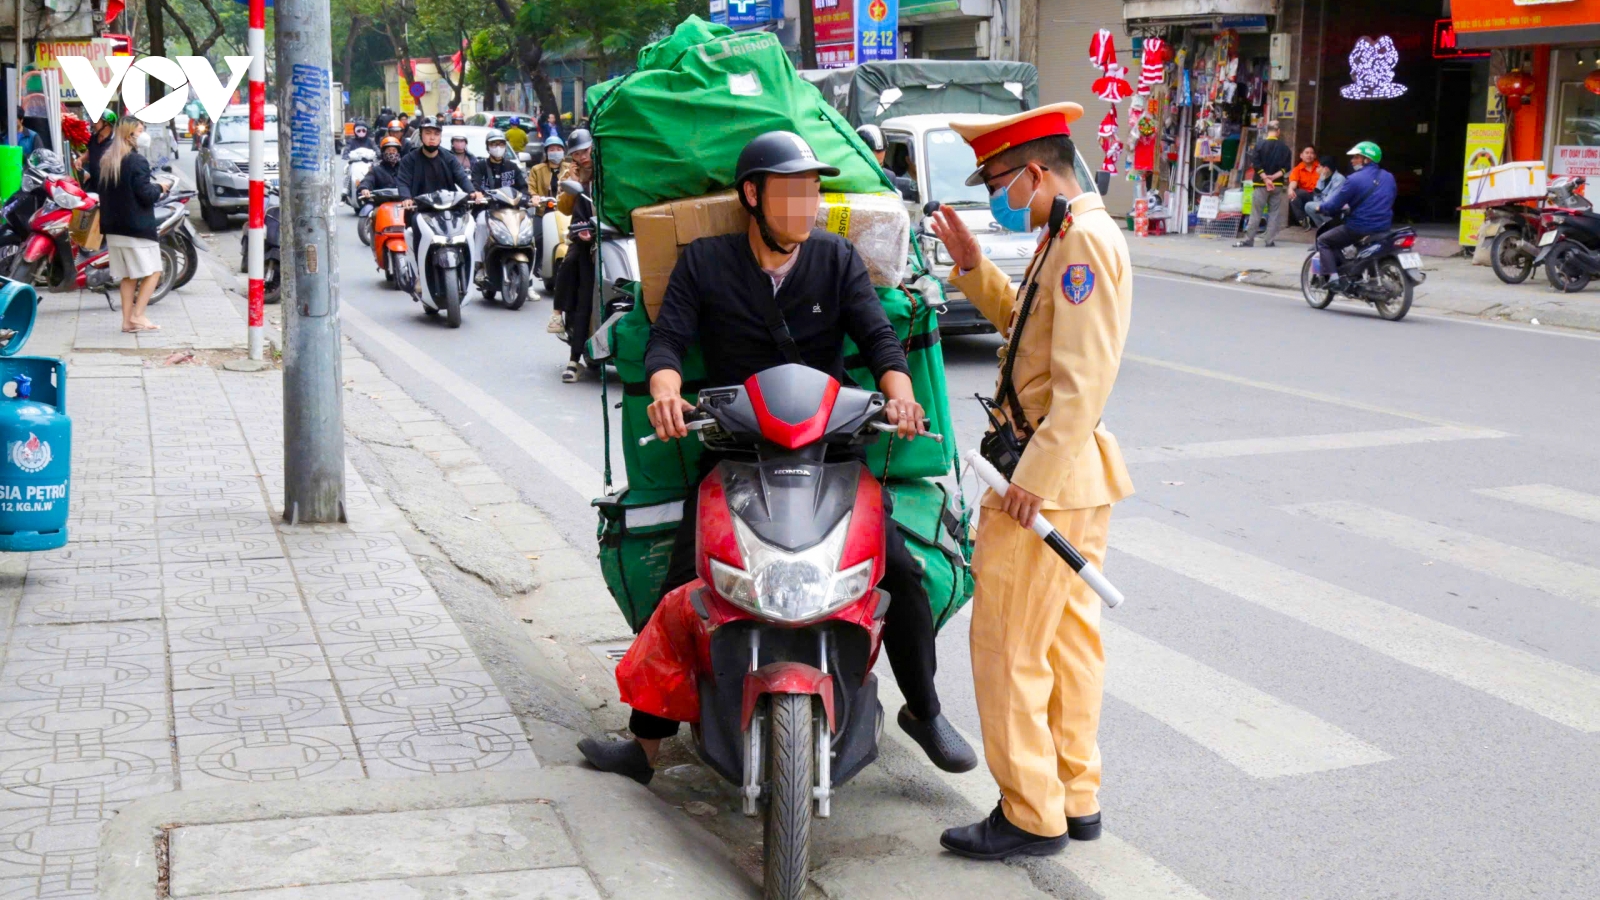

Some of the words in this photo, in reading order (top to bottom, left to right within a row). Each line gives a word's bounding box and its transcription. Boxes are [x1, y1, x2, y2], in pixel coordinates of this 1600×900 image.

[862, 30, 893, 46] 22-12
[39, 42, 107, 61] PHOTOCOPY
[1283, 98, 1290, 111] 7
[838, 206, 849, 238] HOUSE
[26, 484, 66, 500] PETRO
[1, 502, 13, 511] 12
